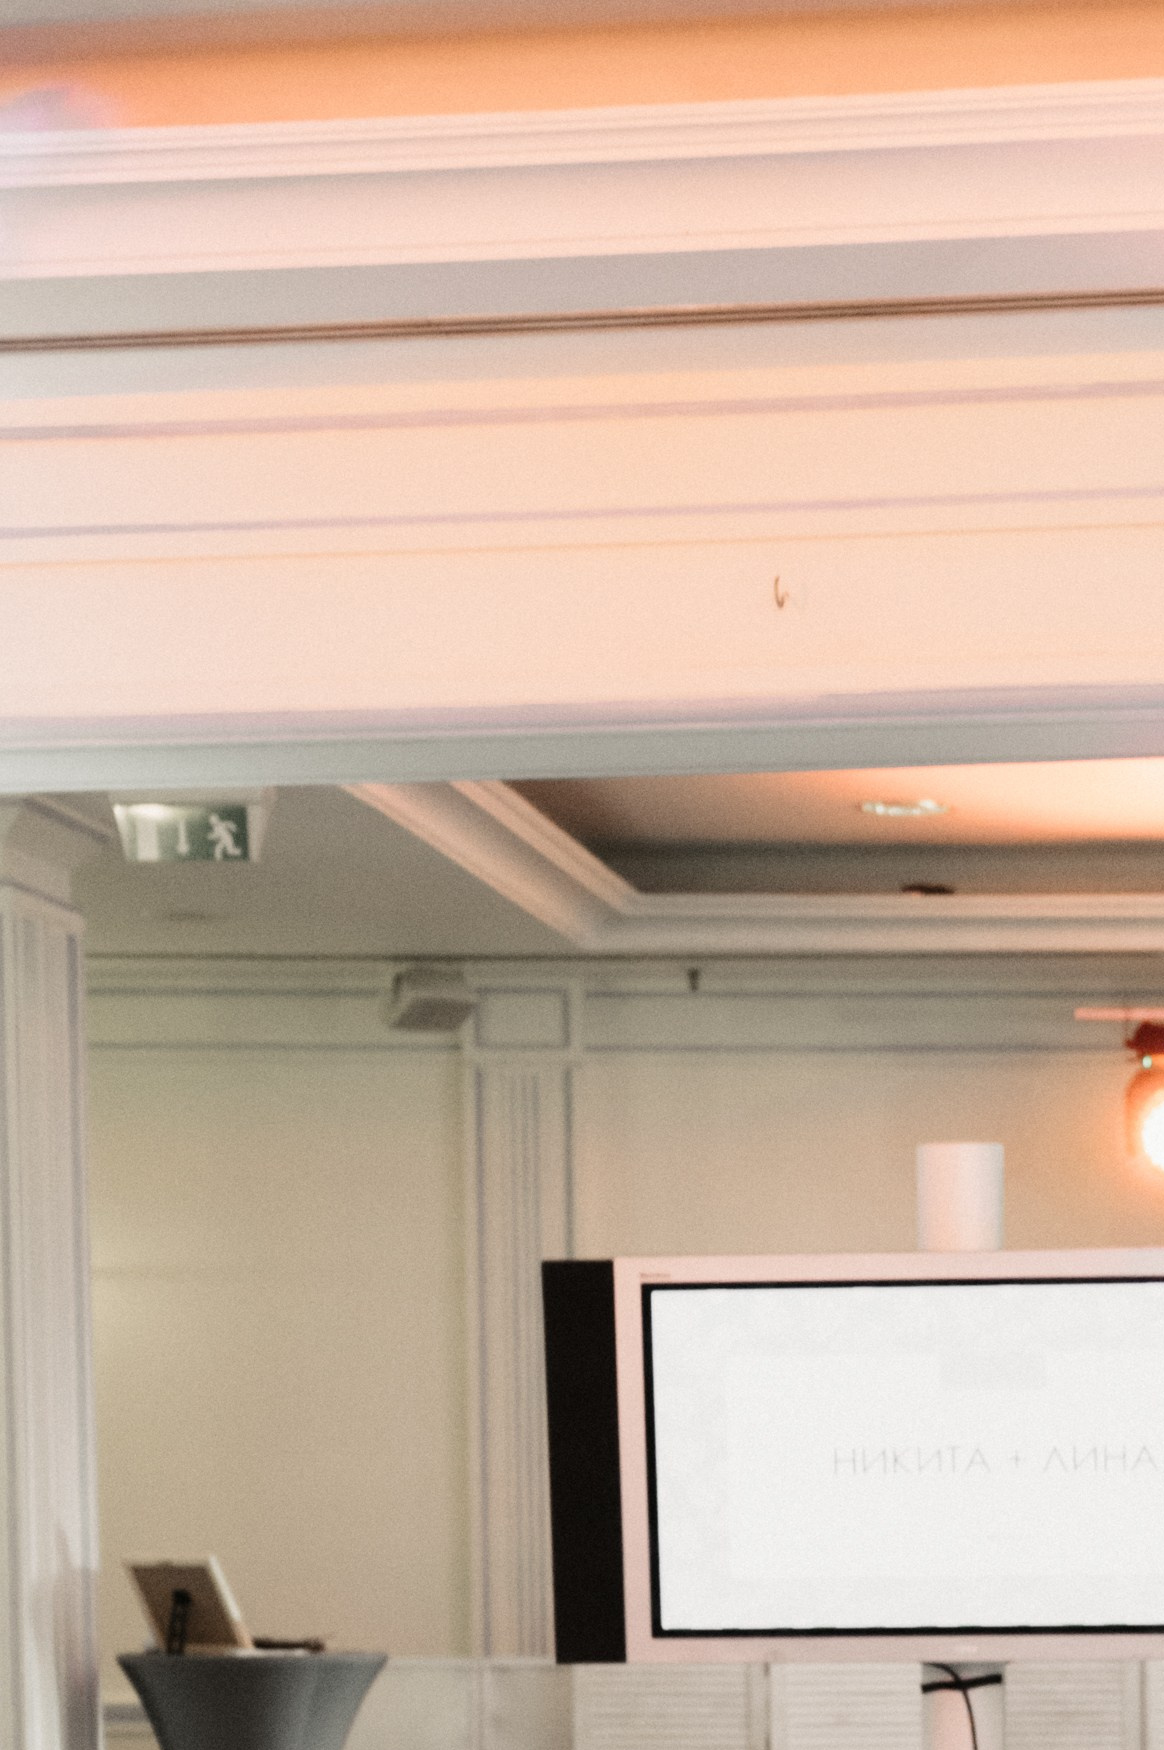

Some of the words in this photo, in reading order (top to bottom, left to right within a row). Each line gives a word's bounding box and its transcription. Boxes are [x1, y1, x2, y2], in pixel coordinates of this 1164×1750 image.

[833, 1444, 991, 1475] НИКИТА
[1008, 1448, 1026, 1468] +
[1042, 1444, 1159, 1473] ЛИНА
